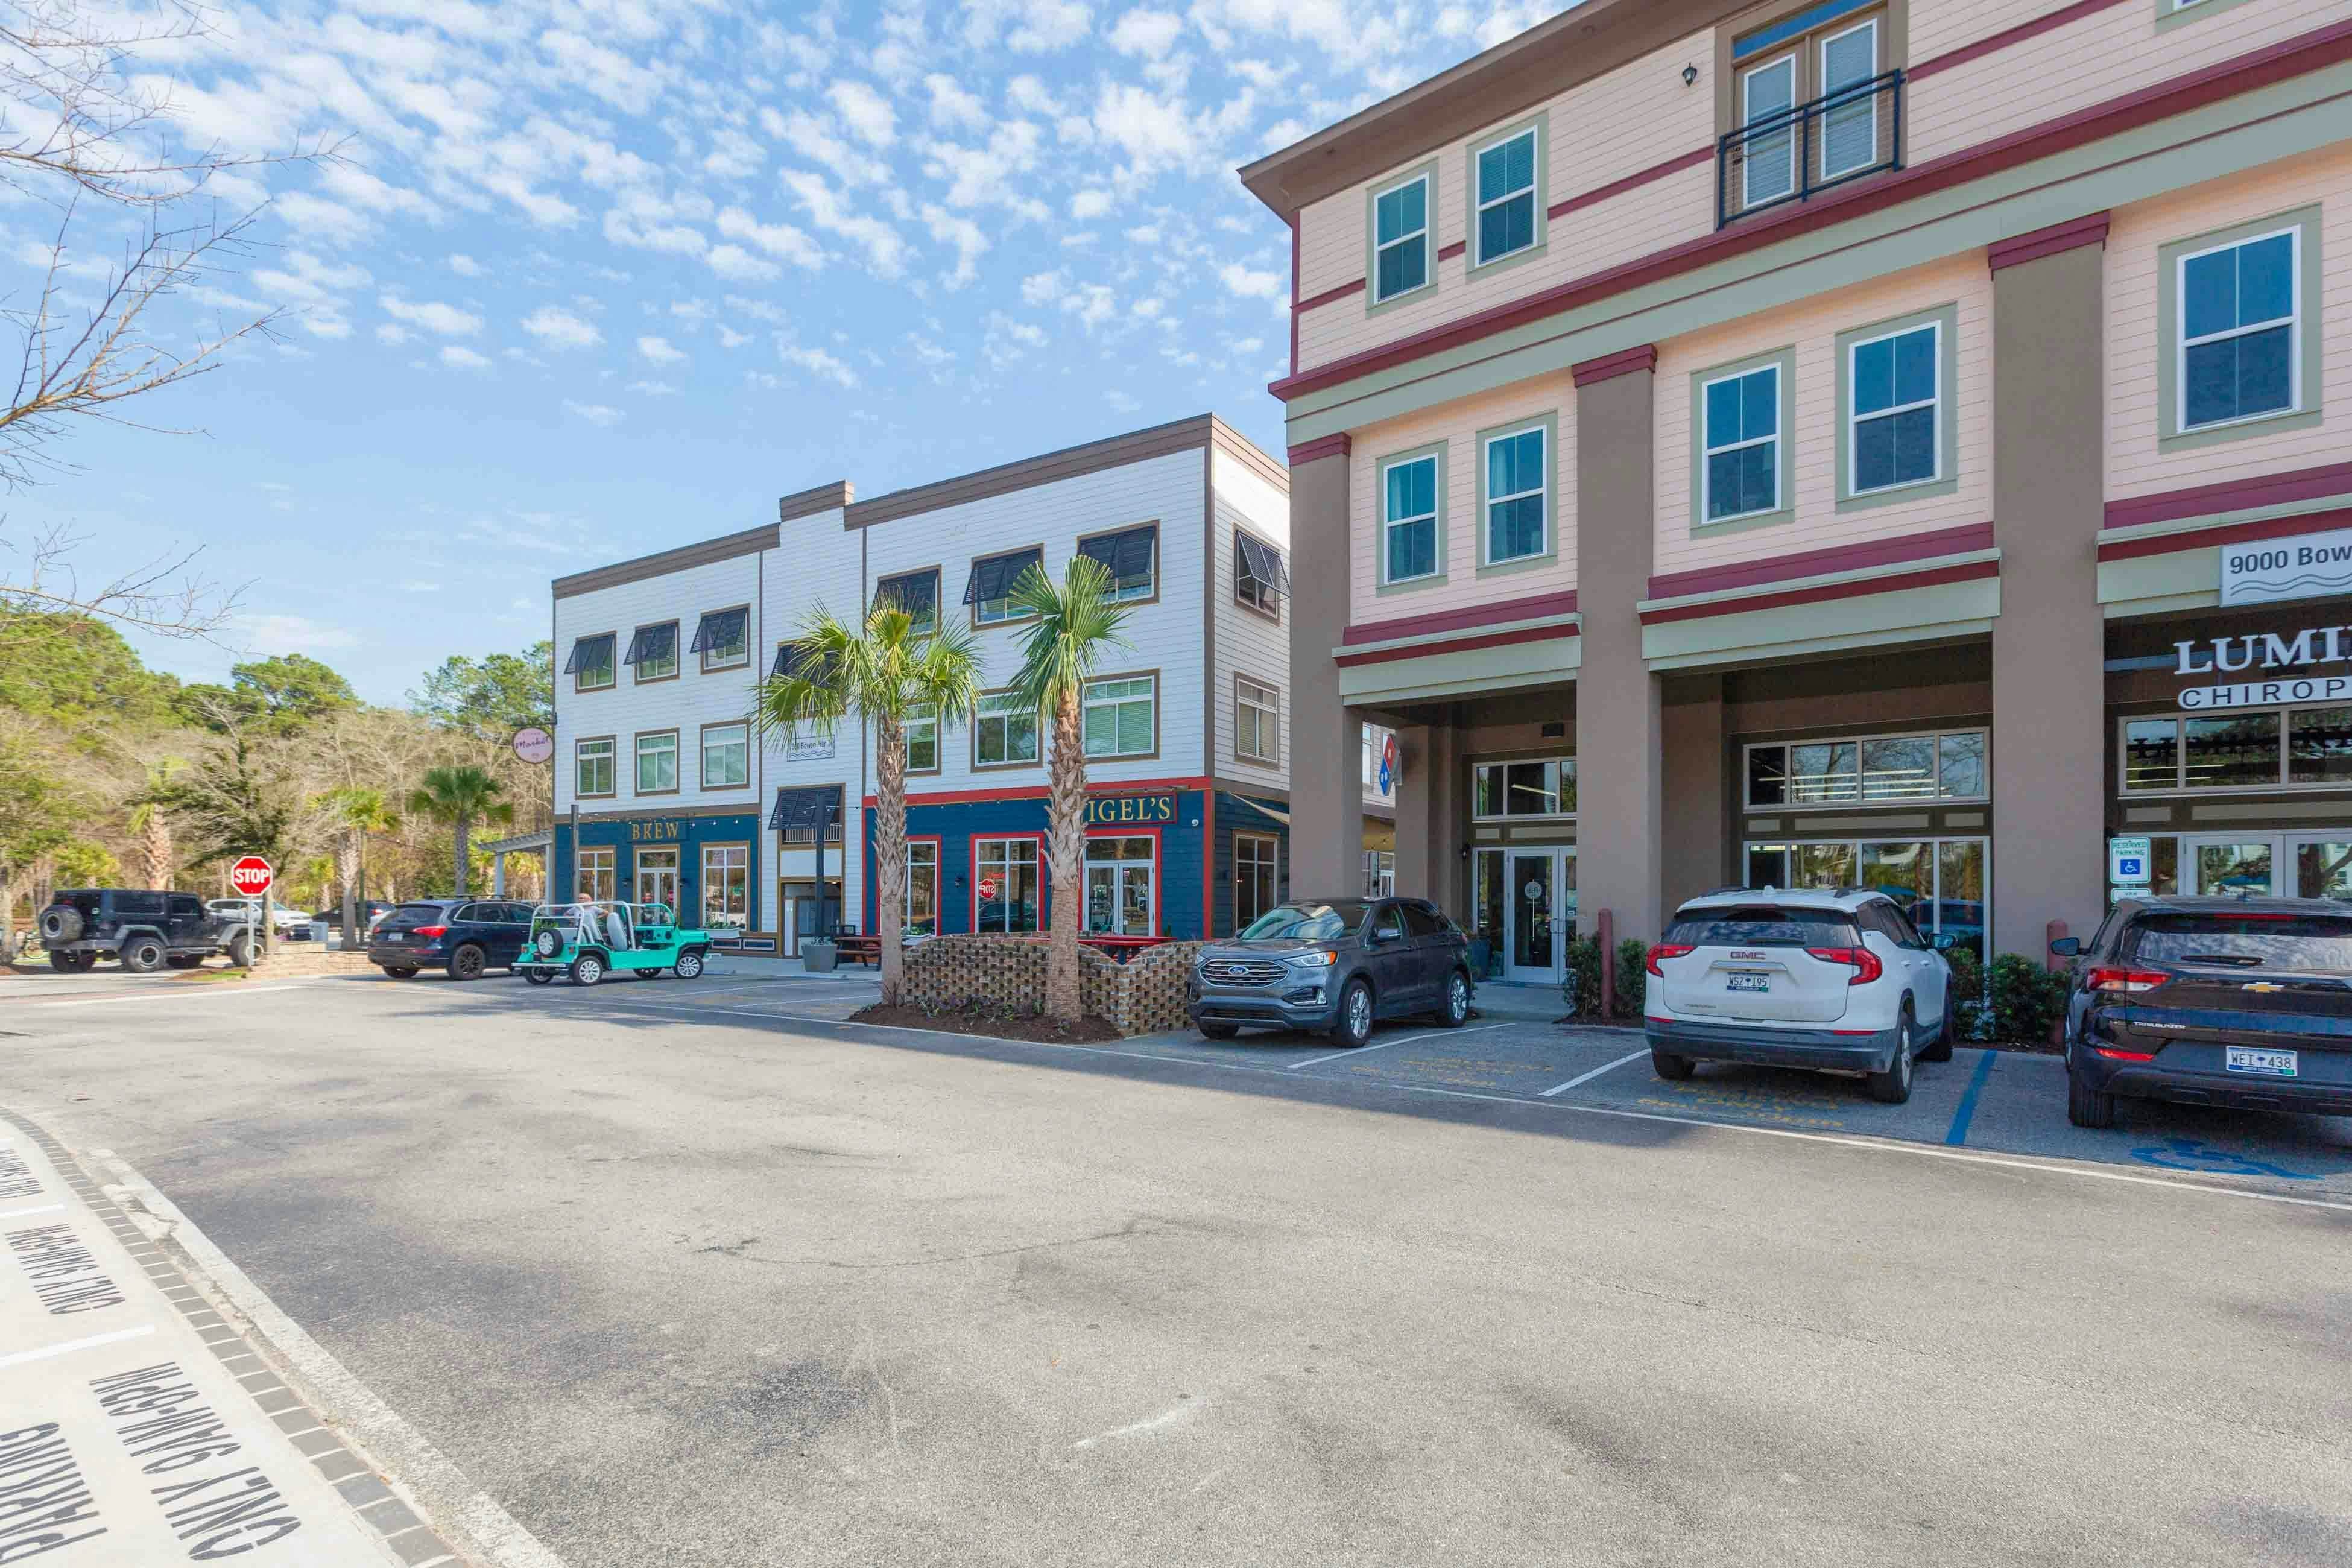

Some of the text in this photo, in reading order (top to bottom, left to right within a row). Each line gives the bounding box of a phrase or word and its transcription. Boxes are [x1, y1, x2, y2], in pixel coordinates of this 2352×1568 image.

[2230, 546, 2352, 574] 9000 Bow
[2182, 678, 2346, 707] CHIROP
[1086, 797, 1171, 821] IGEL'S
[631, 821, 678, 840] BREW
[235, 868, 270, 884] STOP
[1730, 951, 1766, 960] GMC
[1751, 976, 1767, 987] 195
[2231, 1052, 2291, 1069] WEI 438
[88, 1361, 302, 1561] ONLY 9AM-6PM
